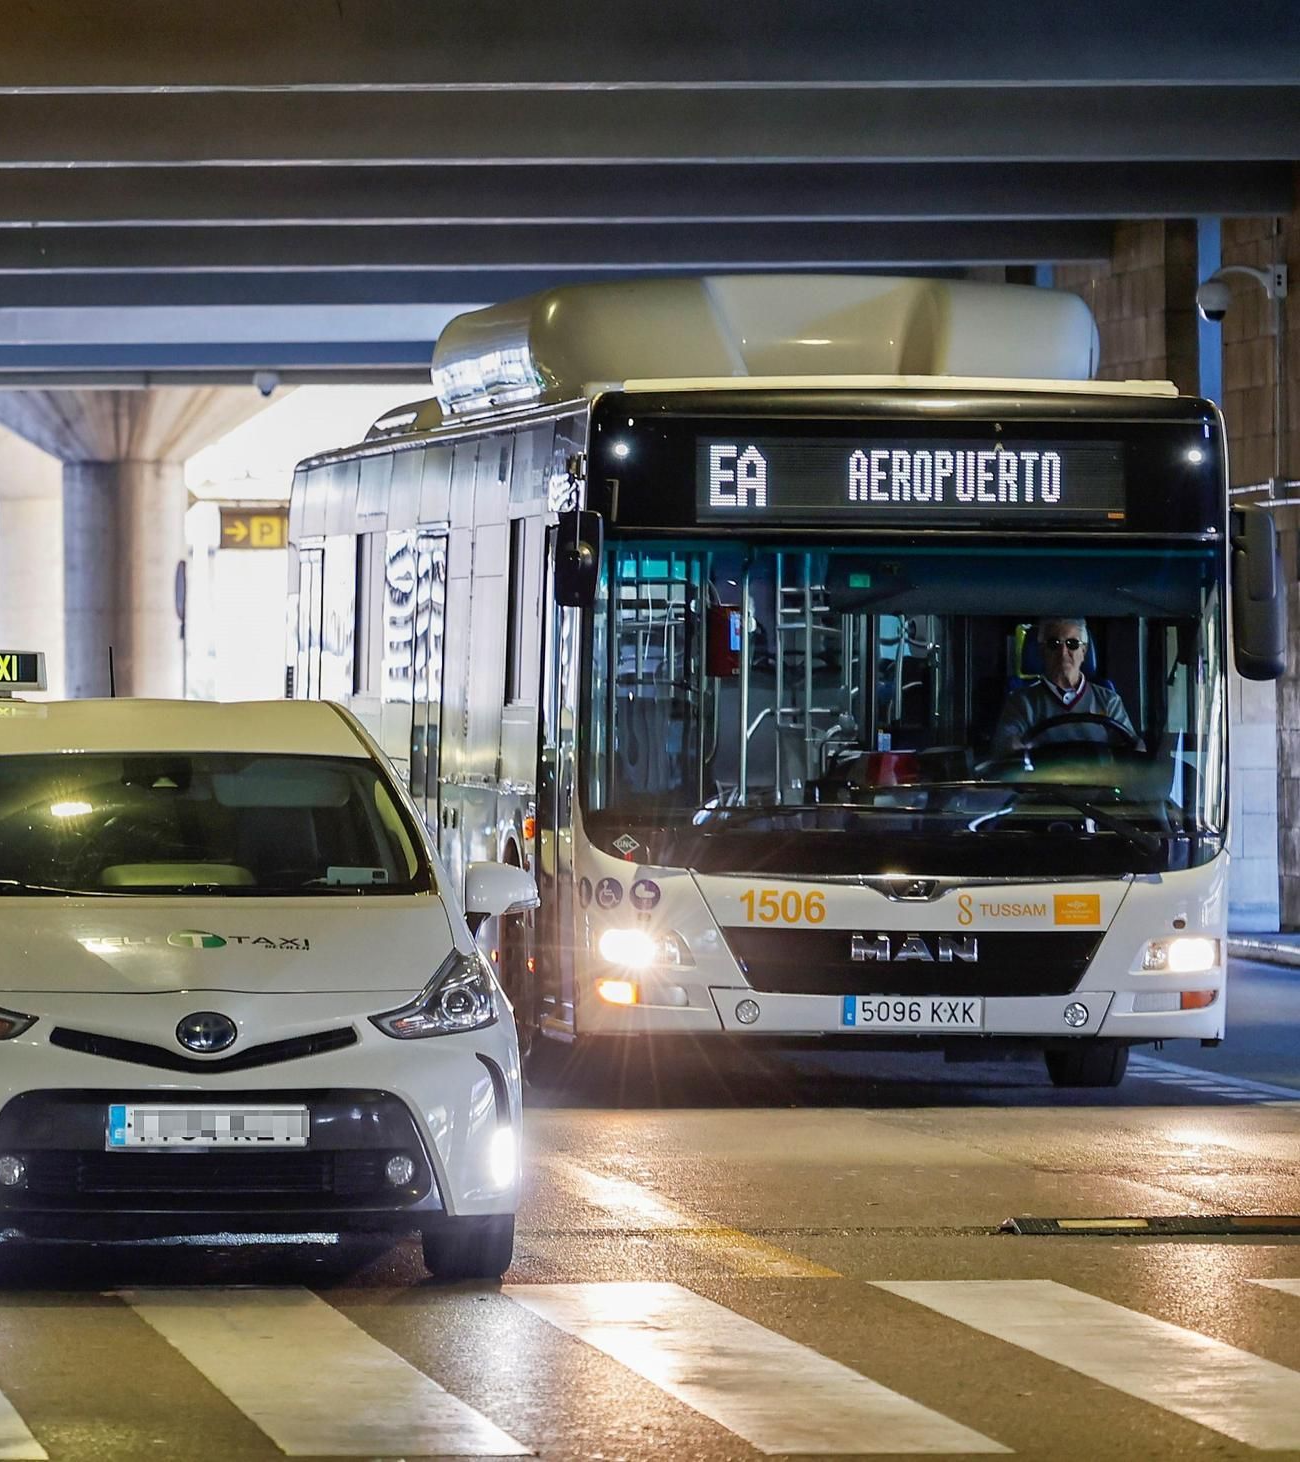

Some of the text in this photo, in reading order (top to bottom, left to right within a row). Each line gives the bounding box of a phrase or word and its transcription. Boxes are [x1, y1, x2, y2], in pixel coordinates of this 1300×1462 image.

[710, 445, 1061, 506] EA AEROPUERTO
[740, 889, 826, 923] 1506
[979, 903, 1046, 916] TUSSAM
[228, 935, 310, 947] TAXI
[851, 933, 978, 962] MAN
[862, 1001, 921, 1022] 5096
[931, 1002, 975, 1023] KXK
